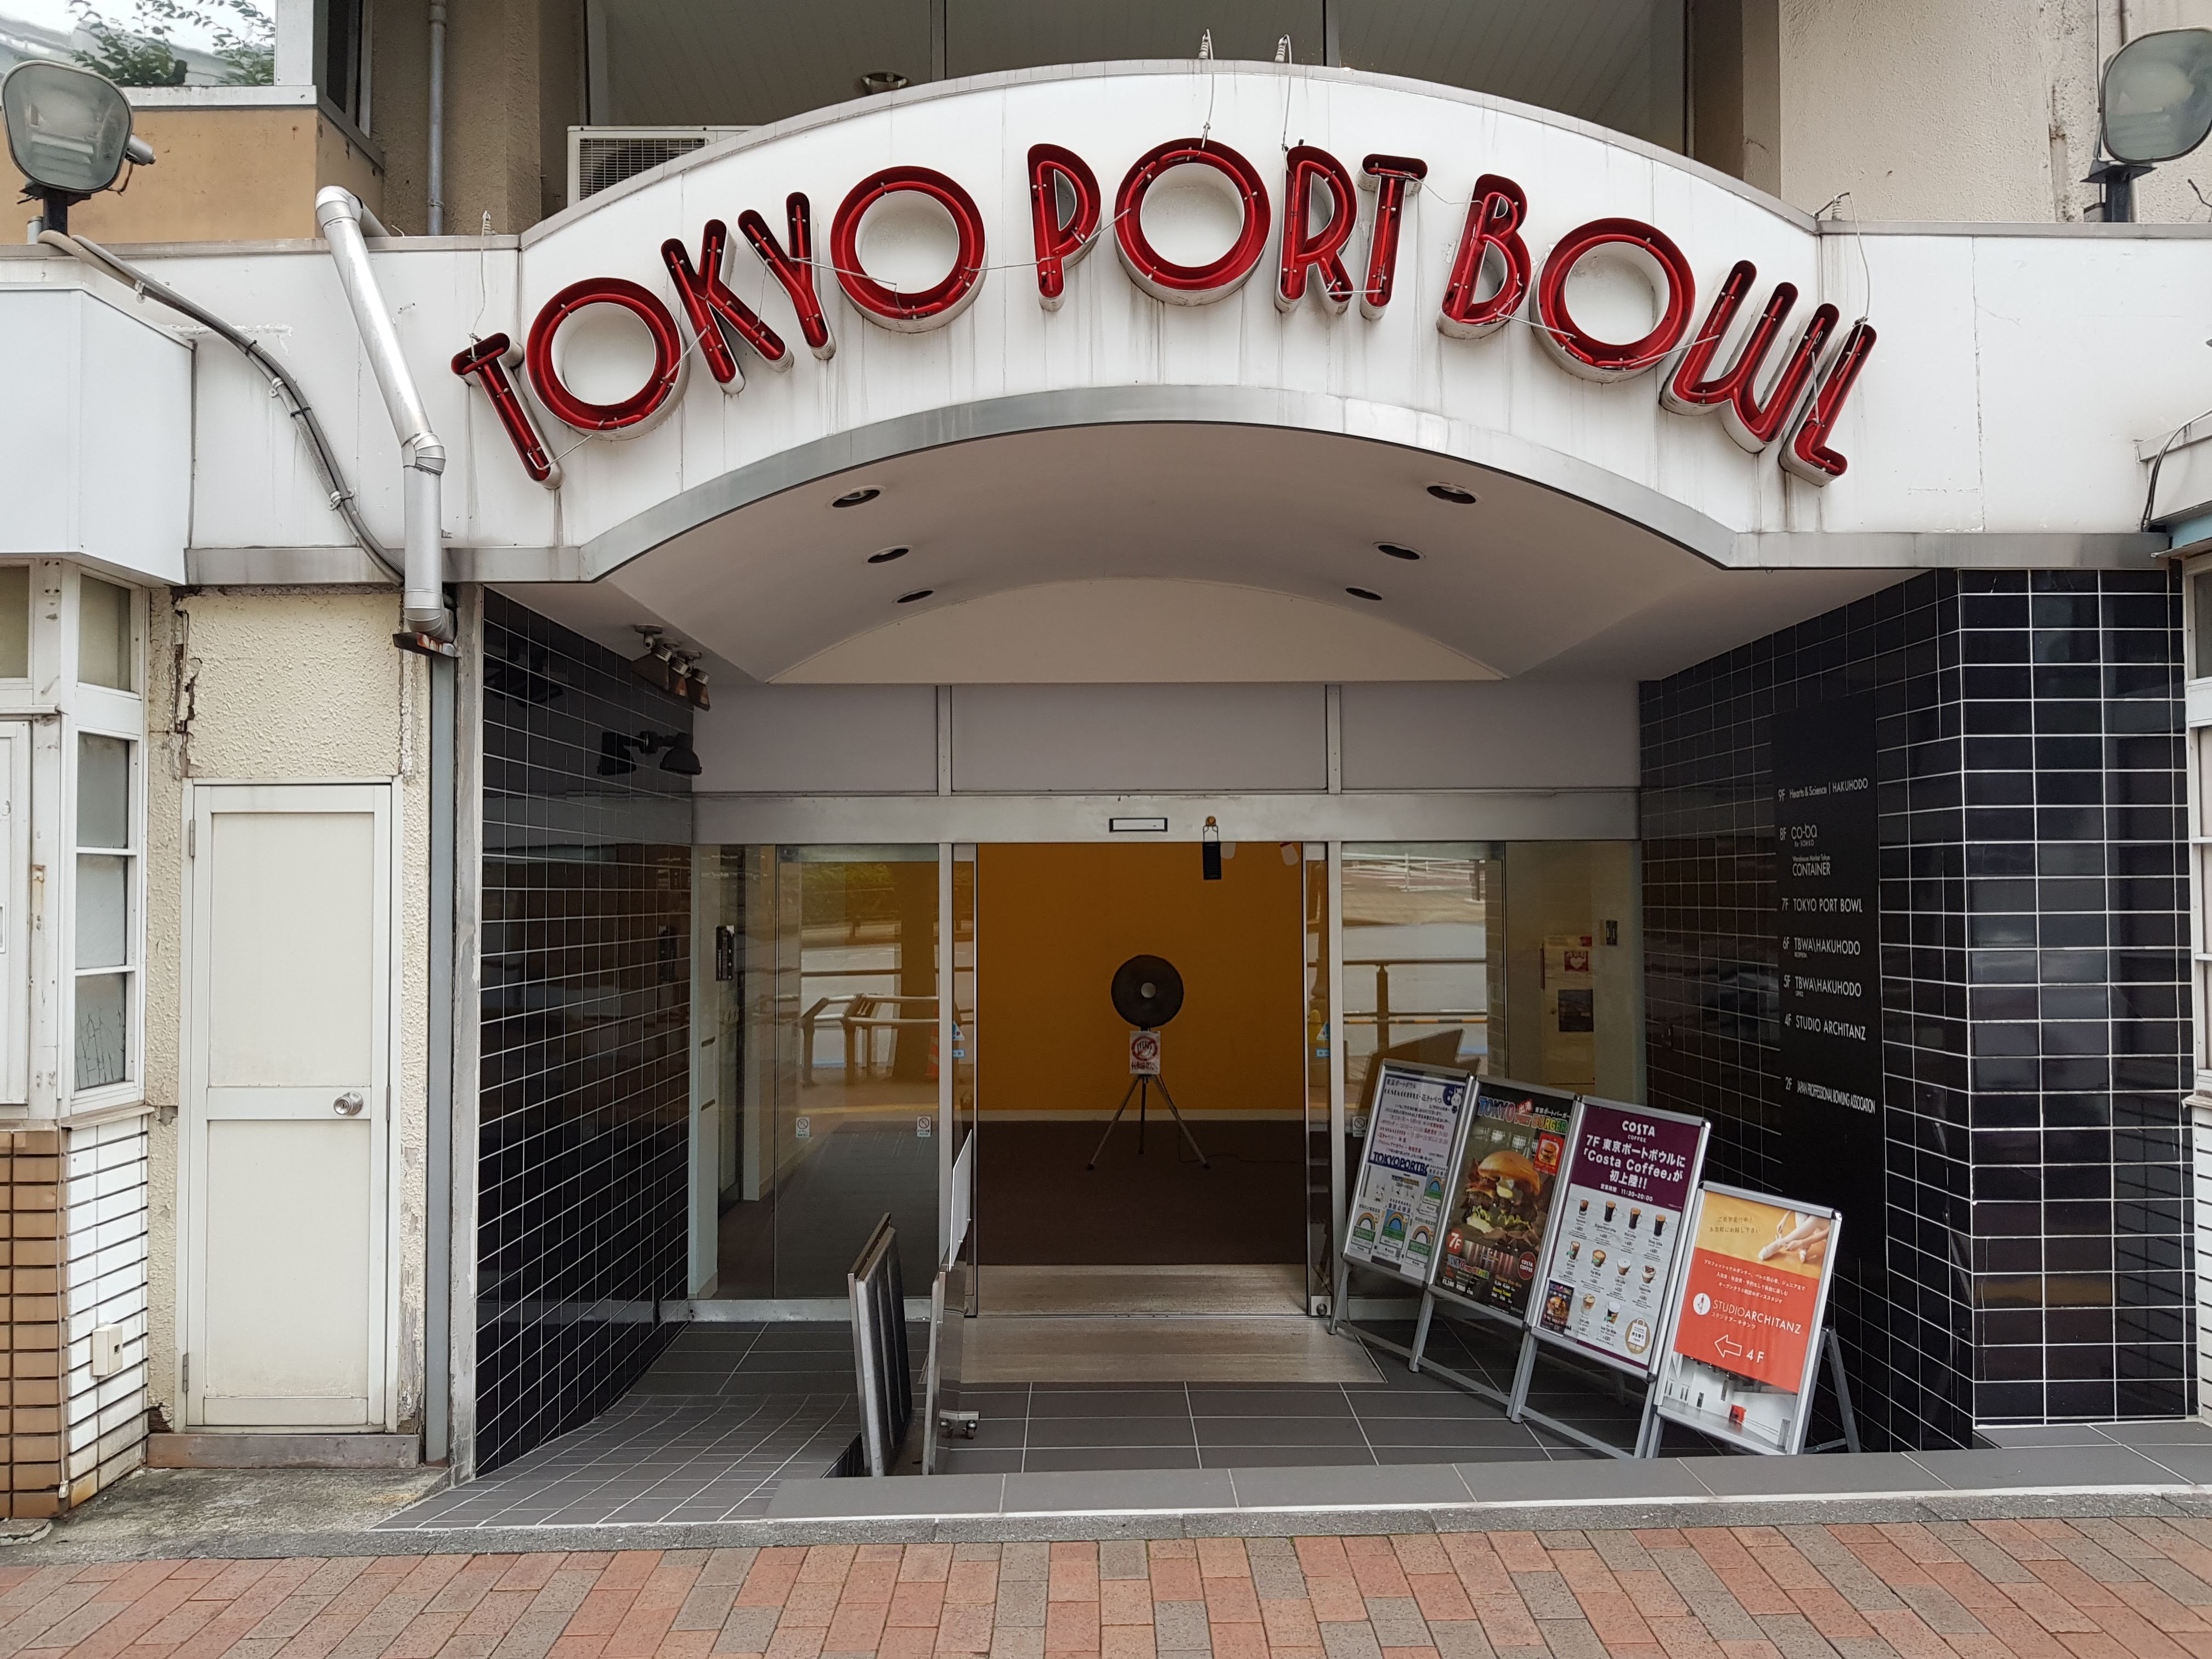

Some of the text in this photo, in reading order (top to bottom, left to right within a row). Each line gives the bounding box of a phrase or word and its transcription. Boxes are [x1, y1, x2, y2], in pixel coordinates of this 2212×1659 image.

[452, 137, 1876, 484] TOKYO PORT BOWL
[1778, 789, 1785, 802] 9F
[1790, 786, 1804, 799] Hearts
[1809, 785, 1827, 796] Science
[1832, 777, 1868, 793] HAKUHODO
[1780, 827, 1786, 840] 8F
[1792, 862, 1831, 877] CONTAINER
[1782, 898, 1863, 913] 7F TOKYO PORT BOWL
[1783, 936, 1861, 956] 6F TBWA\HAKUHODO
[1784, 974, 1862, 997] 5F TBWA\HAKUHODO
[1785, 1013, 1866, 1041] 4F STUDIO ARCHITANZ
[1785, 1076, 1792, 1091] 2F
[1797, 1080, 1808, 1095] JAPAN
[1833, 1089, 1850, 1107] BOWLING
[1850, 1094, 1876, 1114] ASSOCIATION
[1477, 1095, 1516, 1122] TOKYO
[1531, 1113, 1568, 1135] BURGER
[1622, 1120, 1656, 1137] COSTA
[1627, 1134, 1646, 1143] COFFEE
[1586, 1134, 1686, 1168] 7F 東京ポートボウルに
[1448, 1232, 1462, 1249] 7F
[1711, 1311, 1756, 1329] スタジオアーキタンツ
